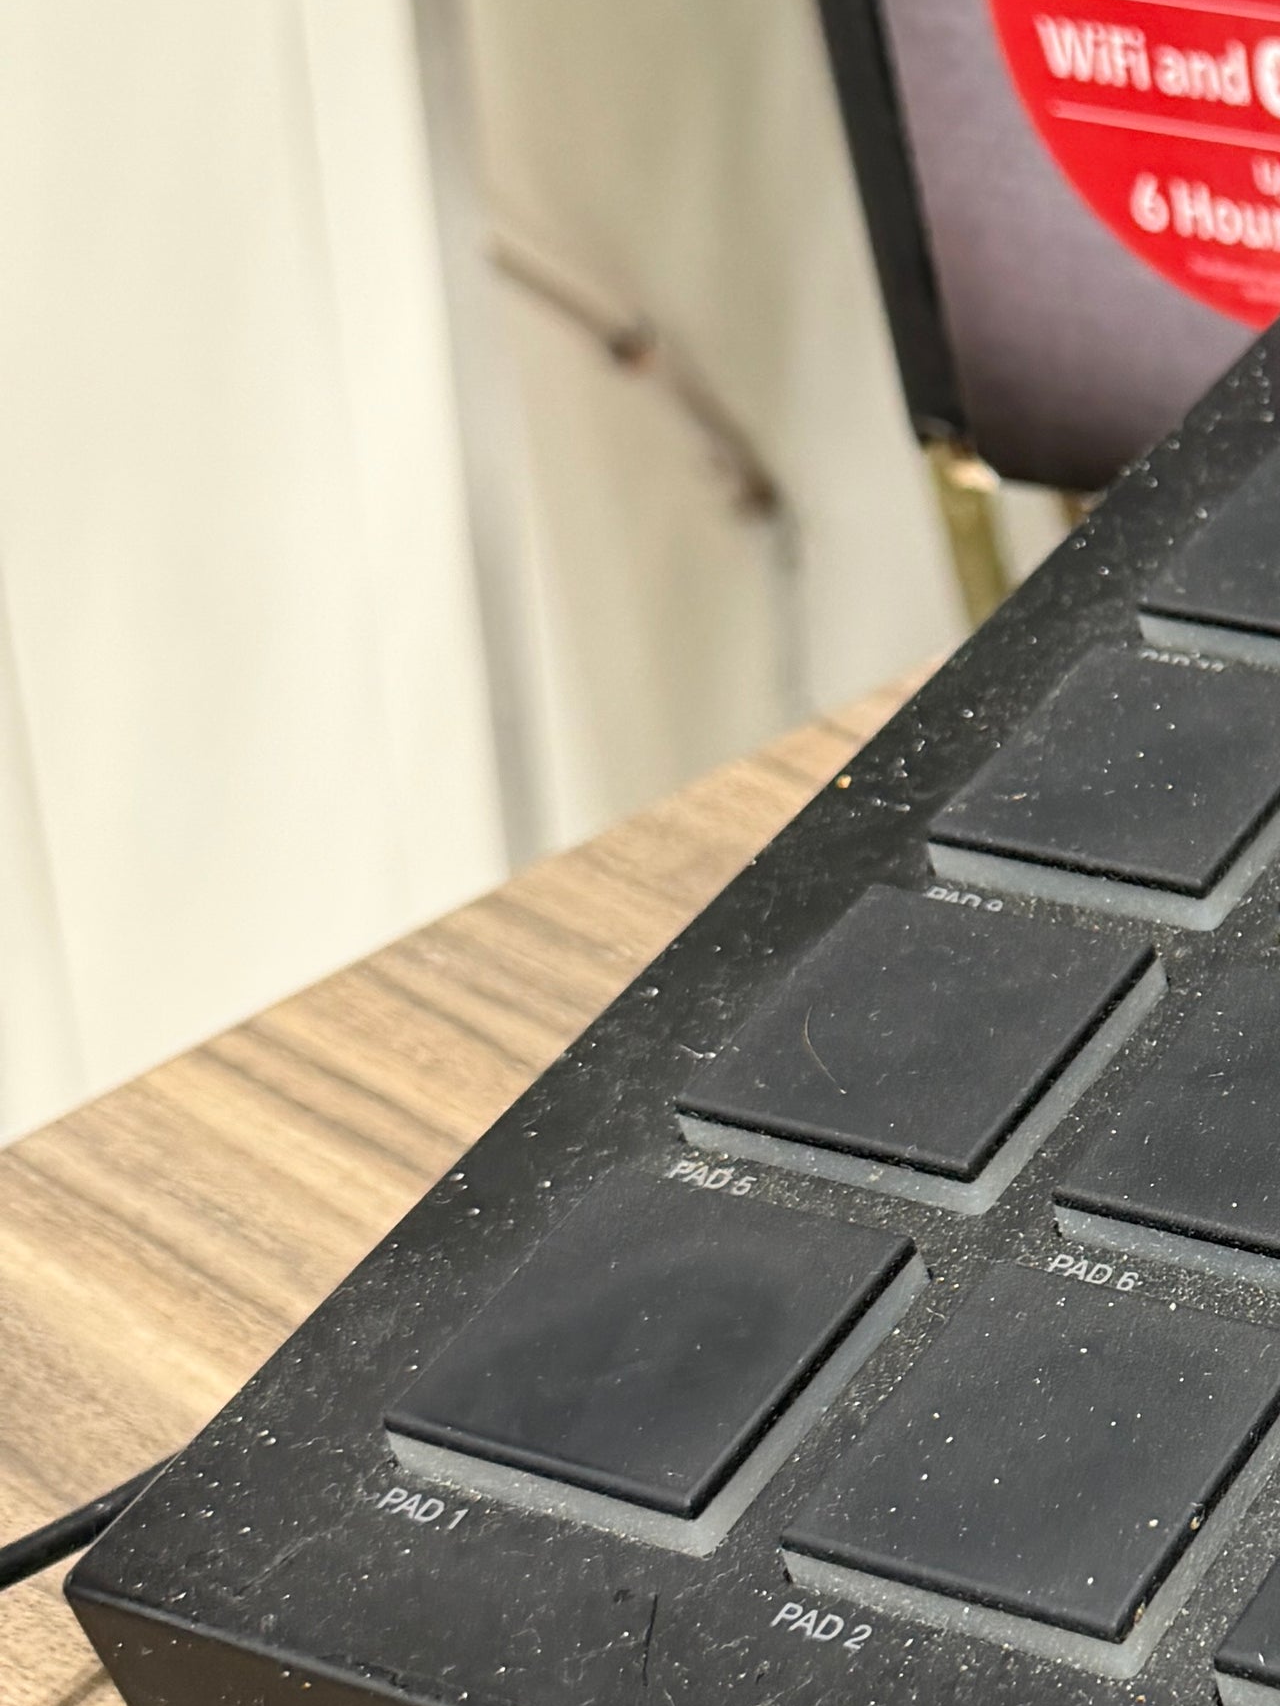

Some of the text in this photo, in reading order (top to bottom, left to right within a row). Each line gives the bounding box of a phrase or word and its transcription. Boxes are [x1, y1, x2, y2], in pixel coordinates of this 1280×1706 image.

[1035, 12, 1151, 92] WiFi
[1153, 39, 1251, 106] and
[1130, 170, 1171, 235] 6
[666, 1159, 735, 1190] PAD
[1046, 1253, 1140, 1292] PAD 6
[377, 1486, 469, 1532] PAD 1
[770, 1600, 873, 1652] PAD 2
